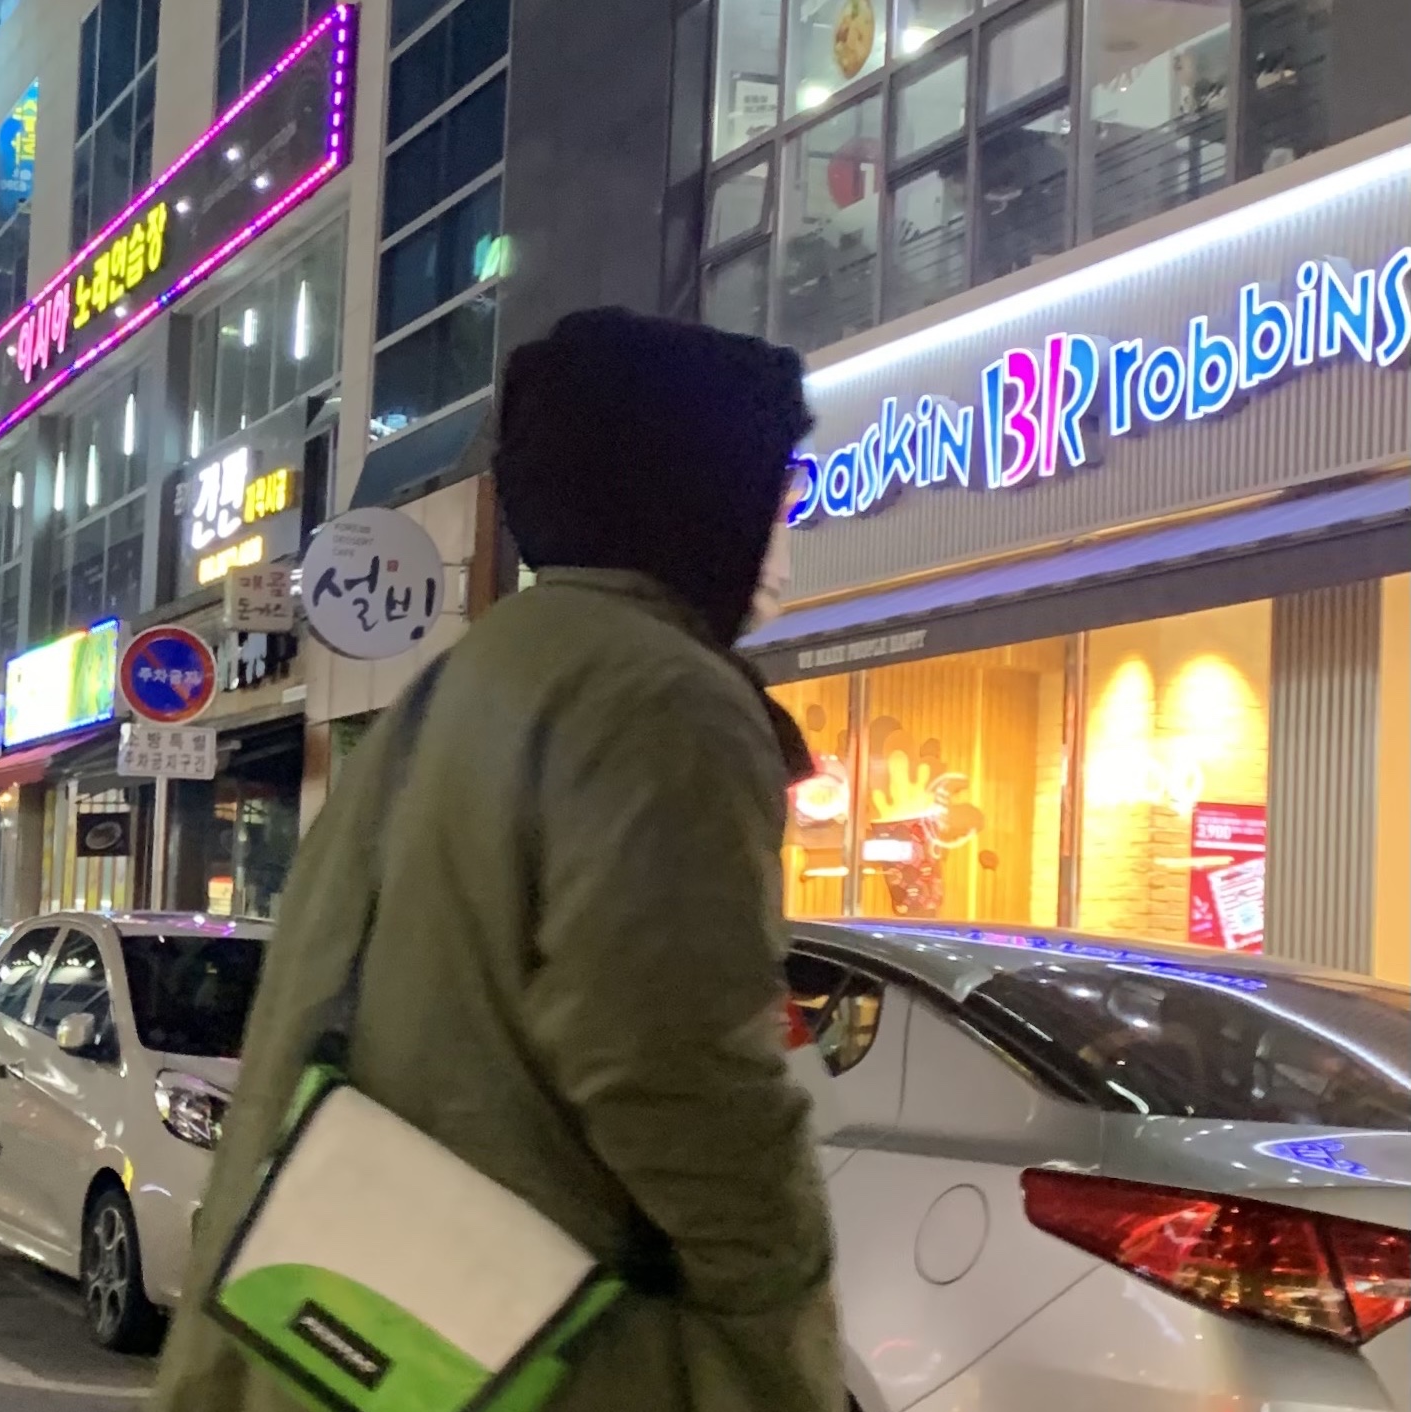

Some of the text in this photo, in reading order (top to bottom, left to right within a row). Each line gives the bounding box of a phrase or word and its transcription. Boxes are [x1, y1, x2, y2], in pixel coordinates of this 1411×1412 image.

[73, 201, 167, 330] 노래연습장
[981, 332, 1100, 489] BR
[311, 555, 436, 641] 설빙
